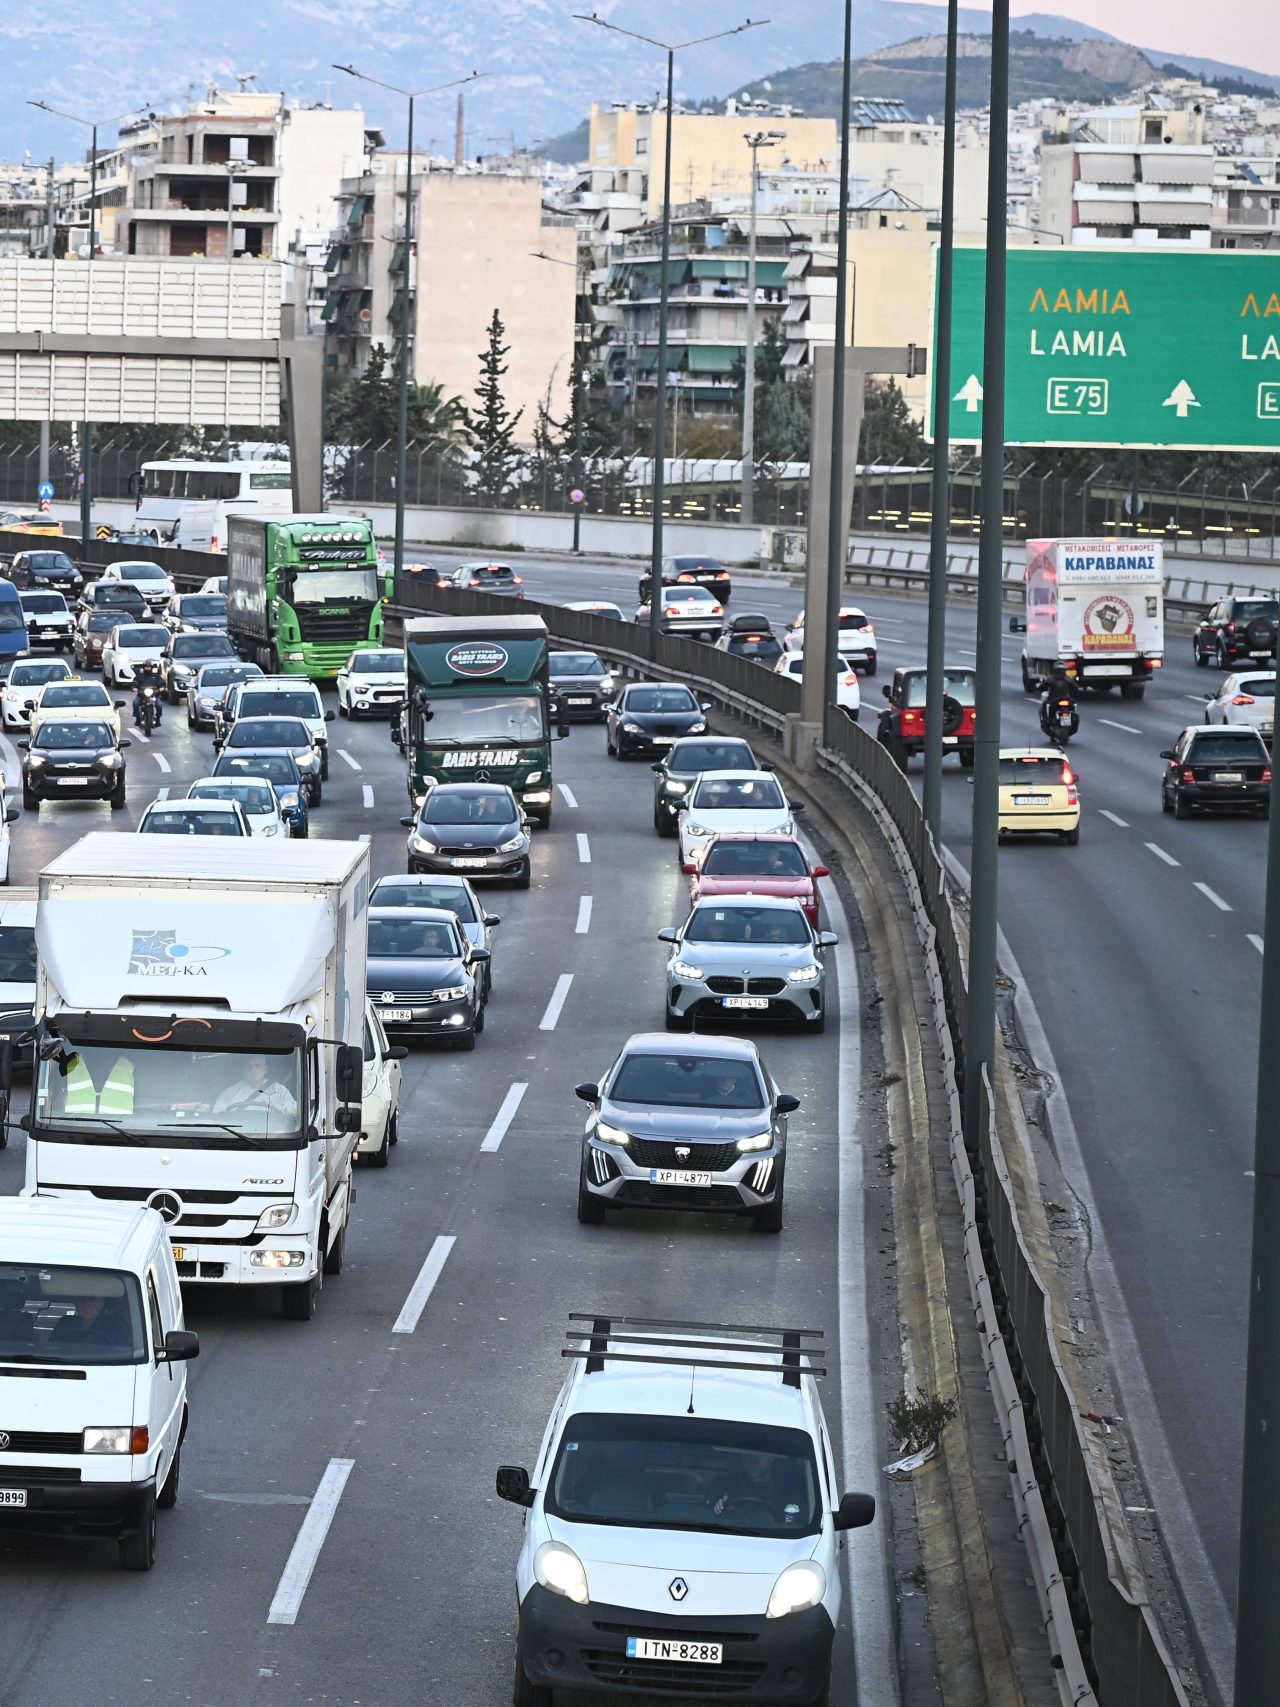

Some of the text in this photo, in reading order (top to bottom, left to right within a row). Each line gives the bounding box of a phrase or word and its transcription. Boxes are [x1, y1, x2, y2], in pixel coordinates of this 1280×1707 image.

[1029, 287, 1131, 315] ΛΑΜΙΑ
[1030, 329, 1127, 357] LAMIA
[1054, 385, 1102, 408] E 75
[1065, 556, 1155, 571] ΚΑΡΑΒΑΝΑΣ
[442, 751, 519, 767] BABIS TRANS
[659, 1171, 709, 1184] XPI-4877
[644, 1641, 719, 1661] ITN-8288
